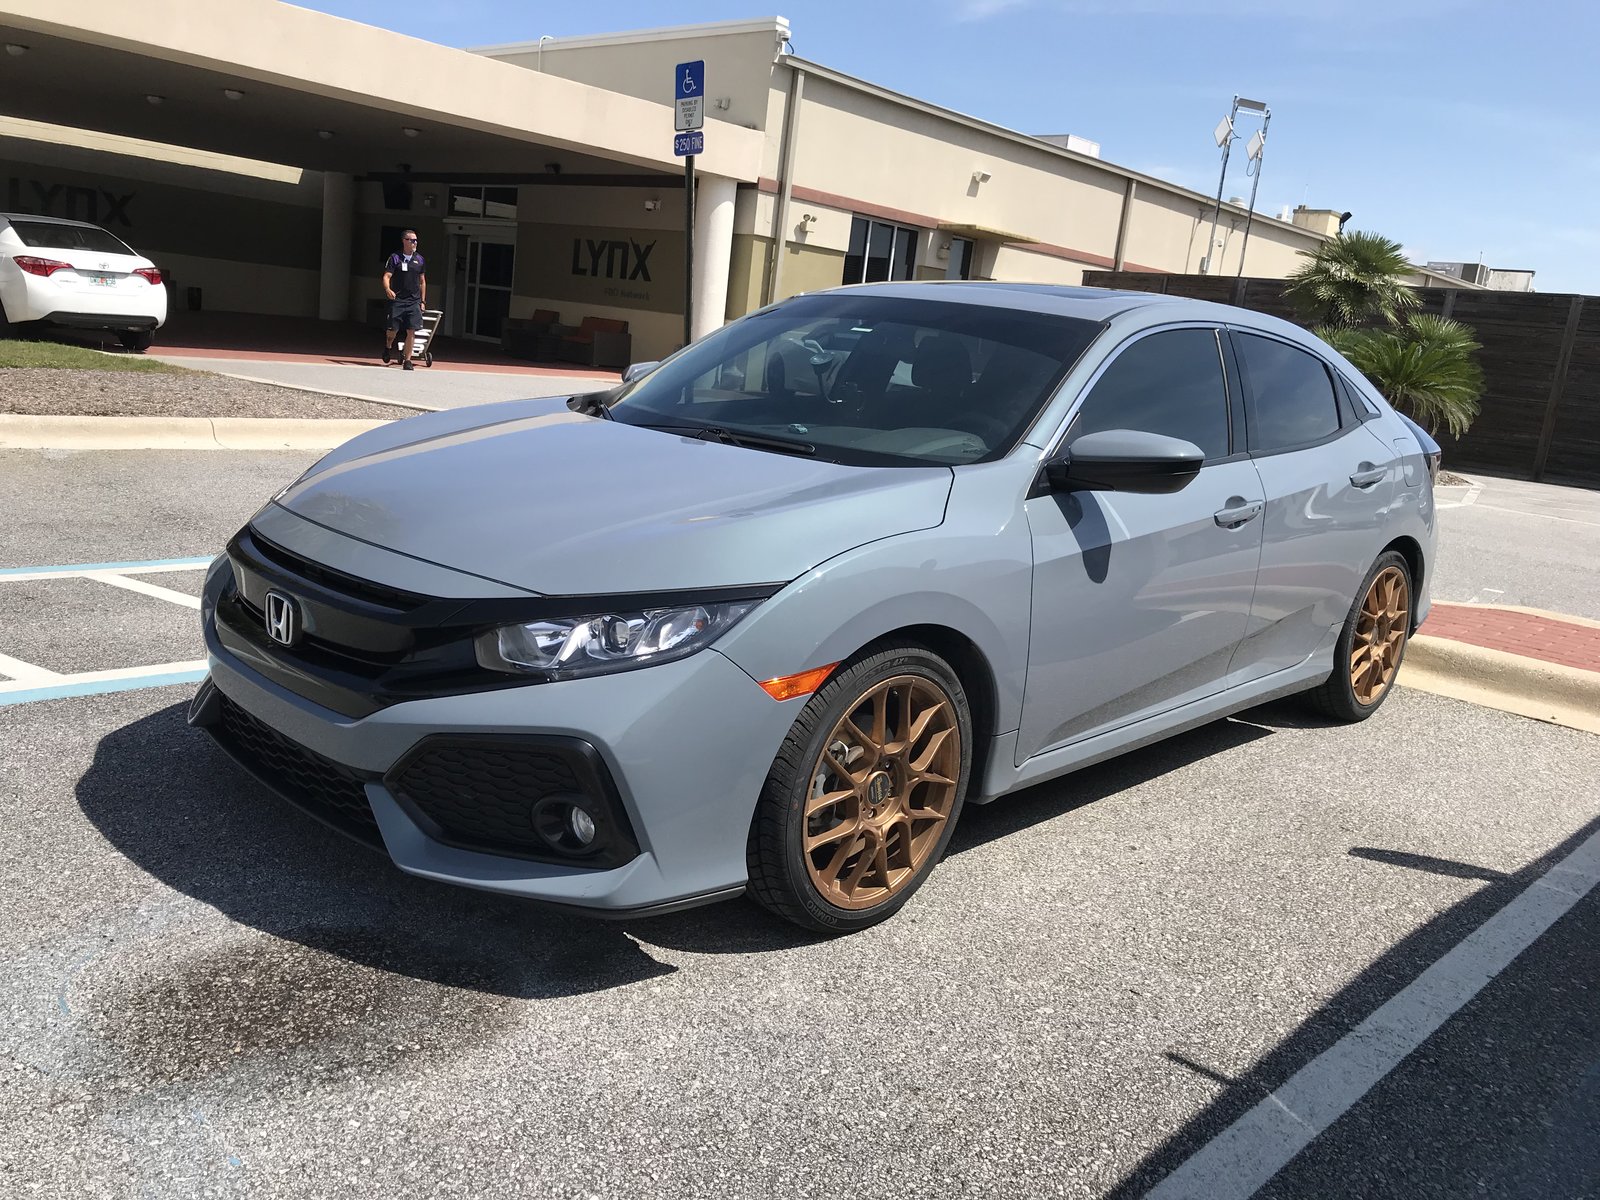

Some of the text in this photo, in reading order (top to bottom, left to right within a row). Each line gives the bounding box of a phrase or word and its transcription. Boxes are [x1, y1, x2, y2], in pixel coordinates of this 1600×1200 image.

[675, 136, 703, 152] $250 FINE
[571, 237, 657, 282] LYNX
